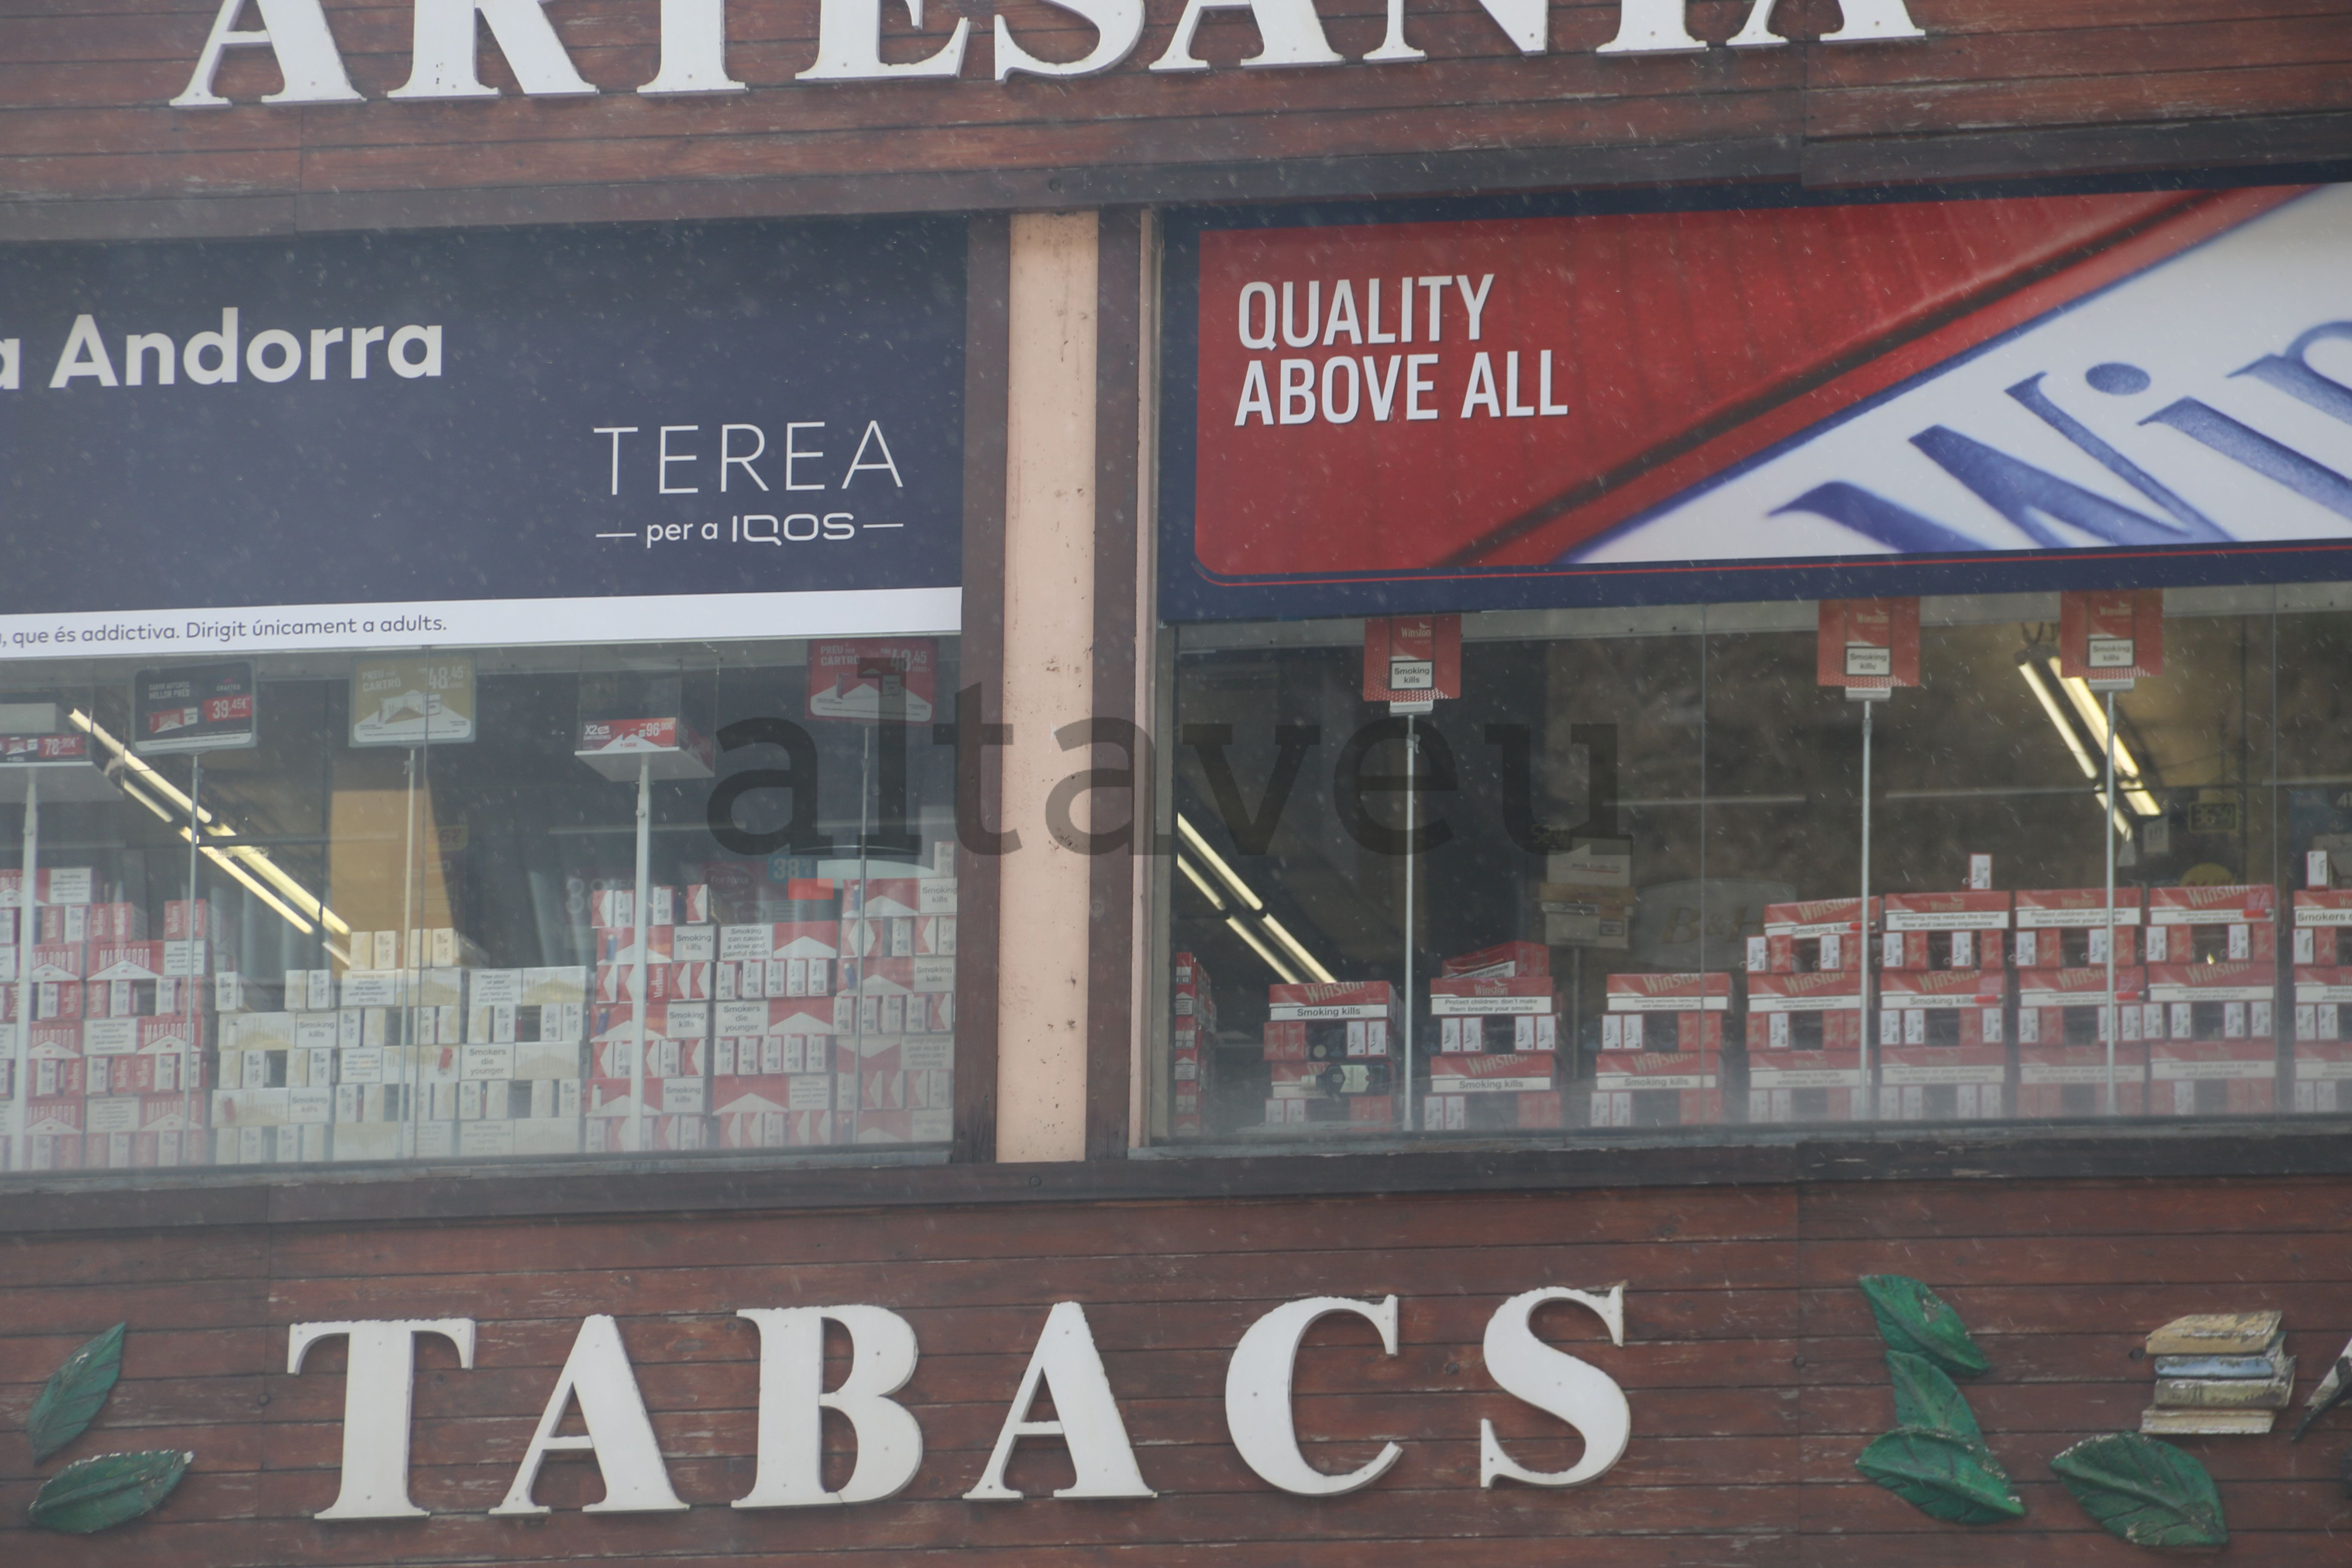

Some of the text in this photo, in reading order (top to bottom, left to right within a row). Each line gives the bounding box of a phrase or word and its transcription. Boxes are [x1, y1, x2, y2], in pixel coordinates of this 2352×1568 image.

[1238, 273, 1495, 351] QUALITY
[49, 307, 442, 388] Andorra
[1234, 349, 1568, 426] ABOVE ALL
[594, 420, 903, 495] TEREA
[646, 512, 855, 548] per a IQOS
[12, 631, 49, 648] que
[55, 626, 76, 643] és
[82, 624, 180, 641] addictiva.
[187, 621, 246, 642] Dirigit
[252, 618, 357, 636] únicament
[363, 621, 374, 632] a
[380, 615, 447, 631] adults.
[1401, 627, 1432, 638] Winston
[821, 645, 843, 654] PREU
[922, 886, 957, 894] Smoking
[2297, 912, 2346, 923] Smokers
[723, 950, 747, 958] painful
[32, 951, 74, 972] ARLBORO
[99, 948, 150, 972] MARLBORO
[916, 965, 952, 974] Smoking
[1642, 974, 1701, 994] Winsto
[1474, 984, 1509, 996] Winston
[1909, 996, 1953, 1006] Smoking
[669, 1011, 705, 1020] Smoking
[1297, 1006, 1361, 1017] Smoking kills
[299, 1021, 335, 1029] Smoking
[725, 1024, 759, 1033] younger
[32, 1029, 75, 1050] ARLBORO
[470, 1068, 504, 1076] younger
[1459, 1080, 1524, 1089] Smoking kills
[1624, 1077, 1690, 1087] Smoking kills
[147, 1101, 196, 1123] MARLBOO
[286, 1284, 1632, 1521] TABACS
